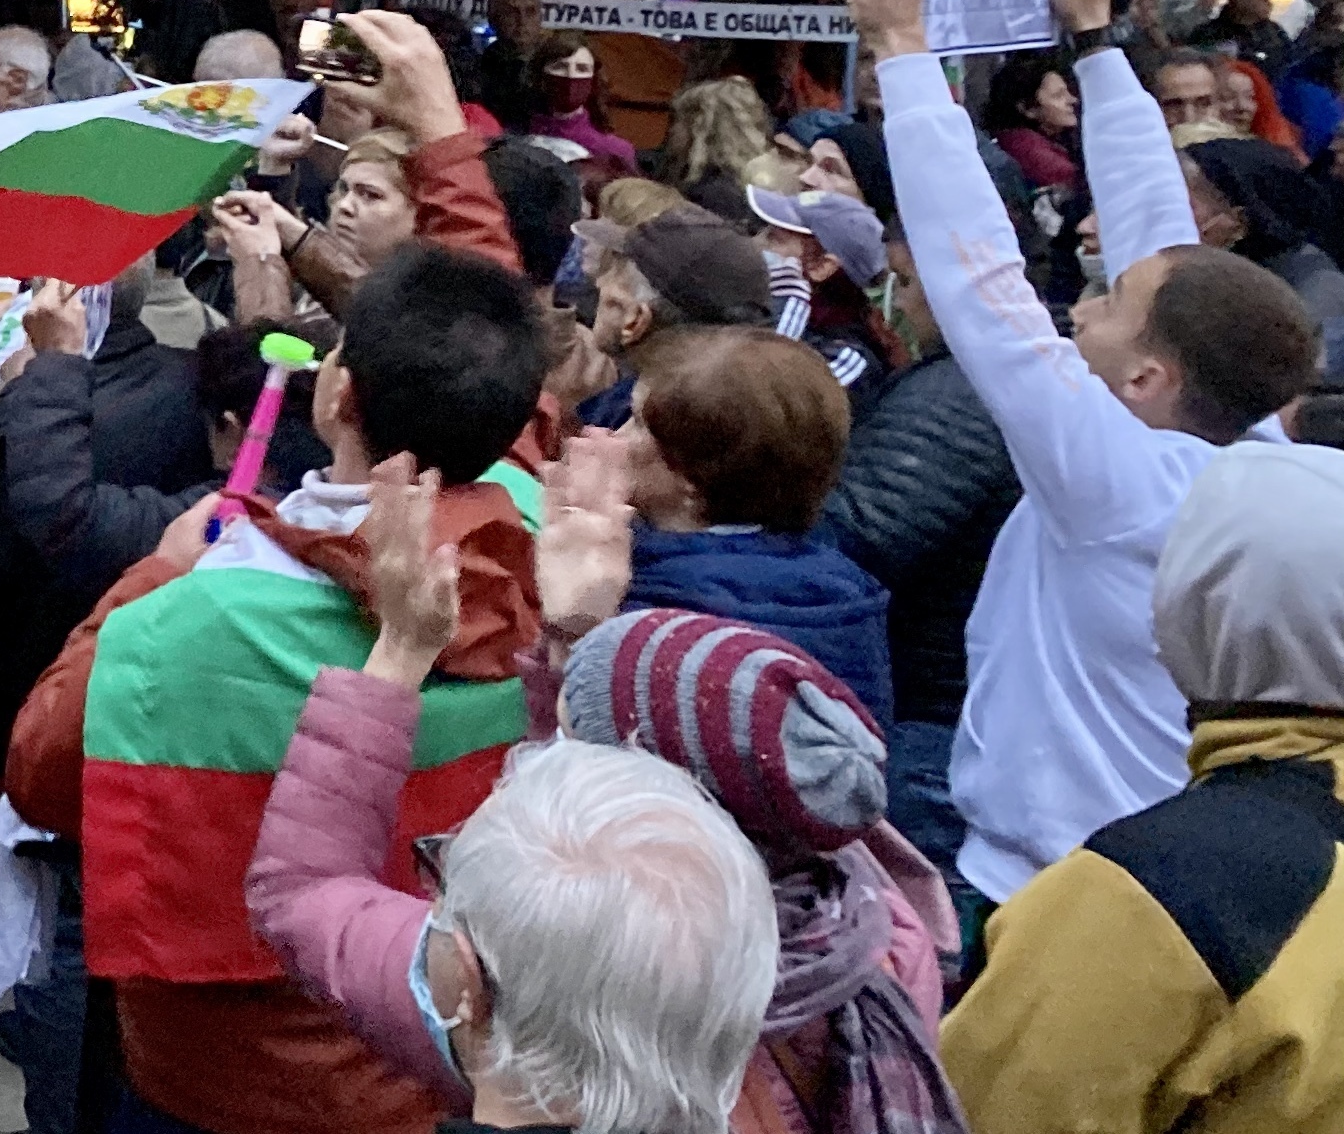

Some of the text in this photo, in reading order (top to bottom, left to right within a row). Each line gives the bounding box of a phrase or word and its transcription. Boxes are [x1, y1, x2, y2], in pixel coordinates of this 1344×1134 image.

[640, 9, 698, 30] ТОВА
[704, 11, 717, 31] Е
[724, 13, 820, 35] ОБЩАТА
